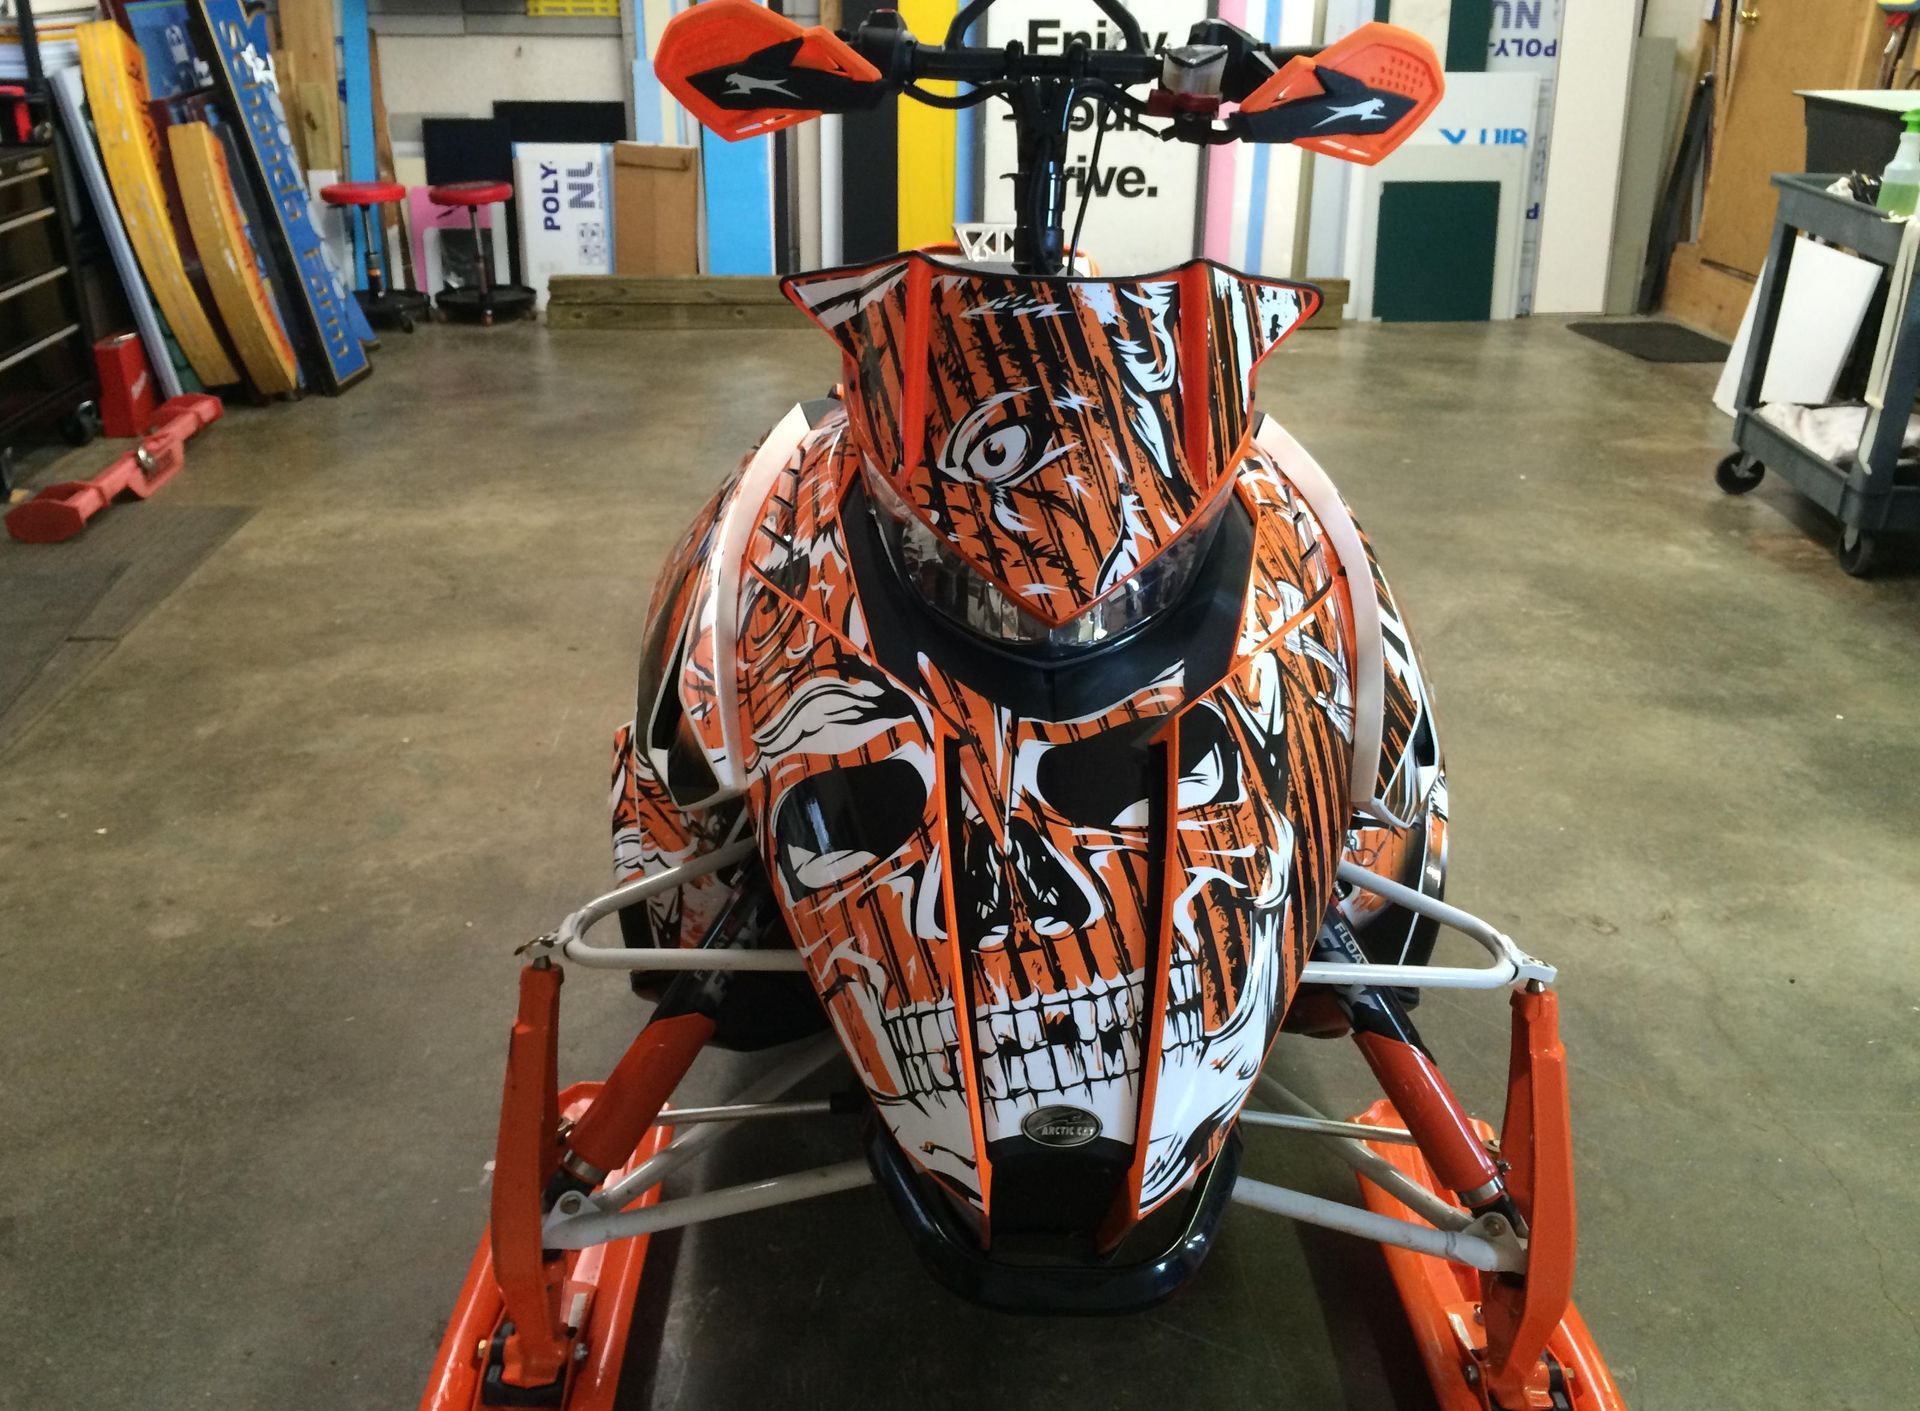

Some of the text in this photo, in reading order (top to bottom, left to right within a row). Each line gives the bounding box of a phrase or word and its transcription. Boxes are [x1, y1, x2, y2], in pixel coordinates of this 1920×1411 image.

[1028, 19, 1168, 54] Enj
[1064, 155, 1158, 198] rive.
[303, 247, 349, 358] Farm
[1334, 921, 1363, 964] FLOA
[1041, 1126, 1096, 1136] ARCTIC CAT
